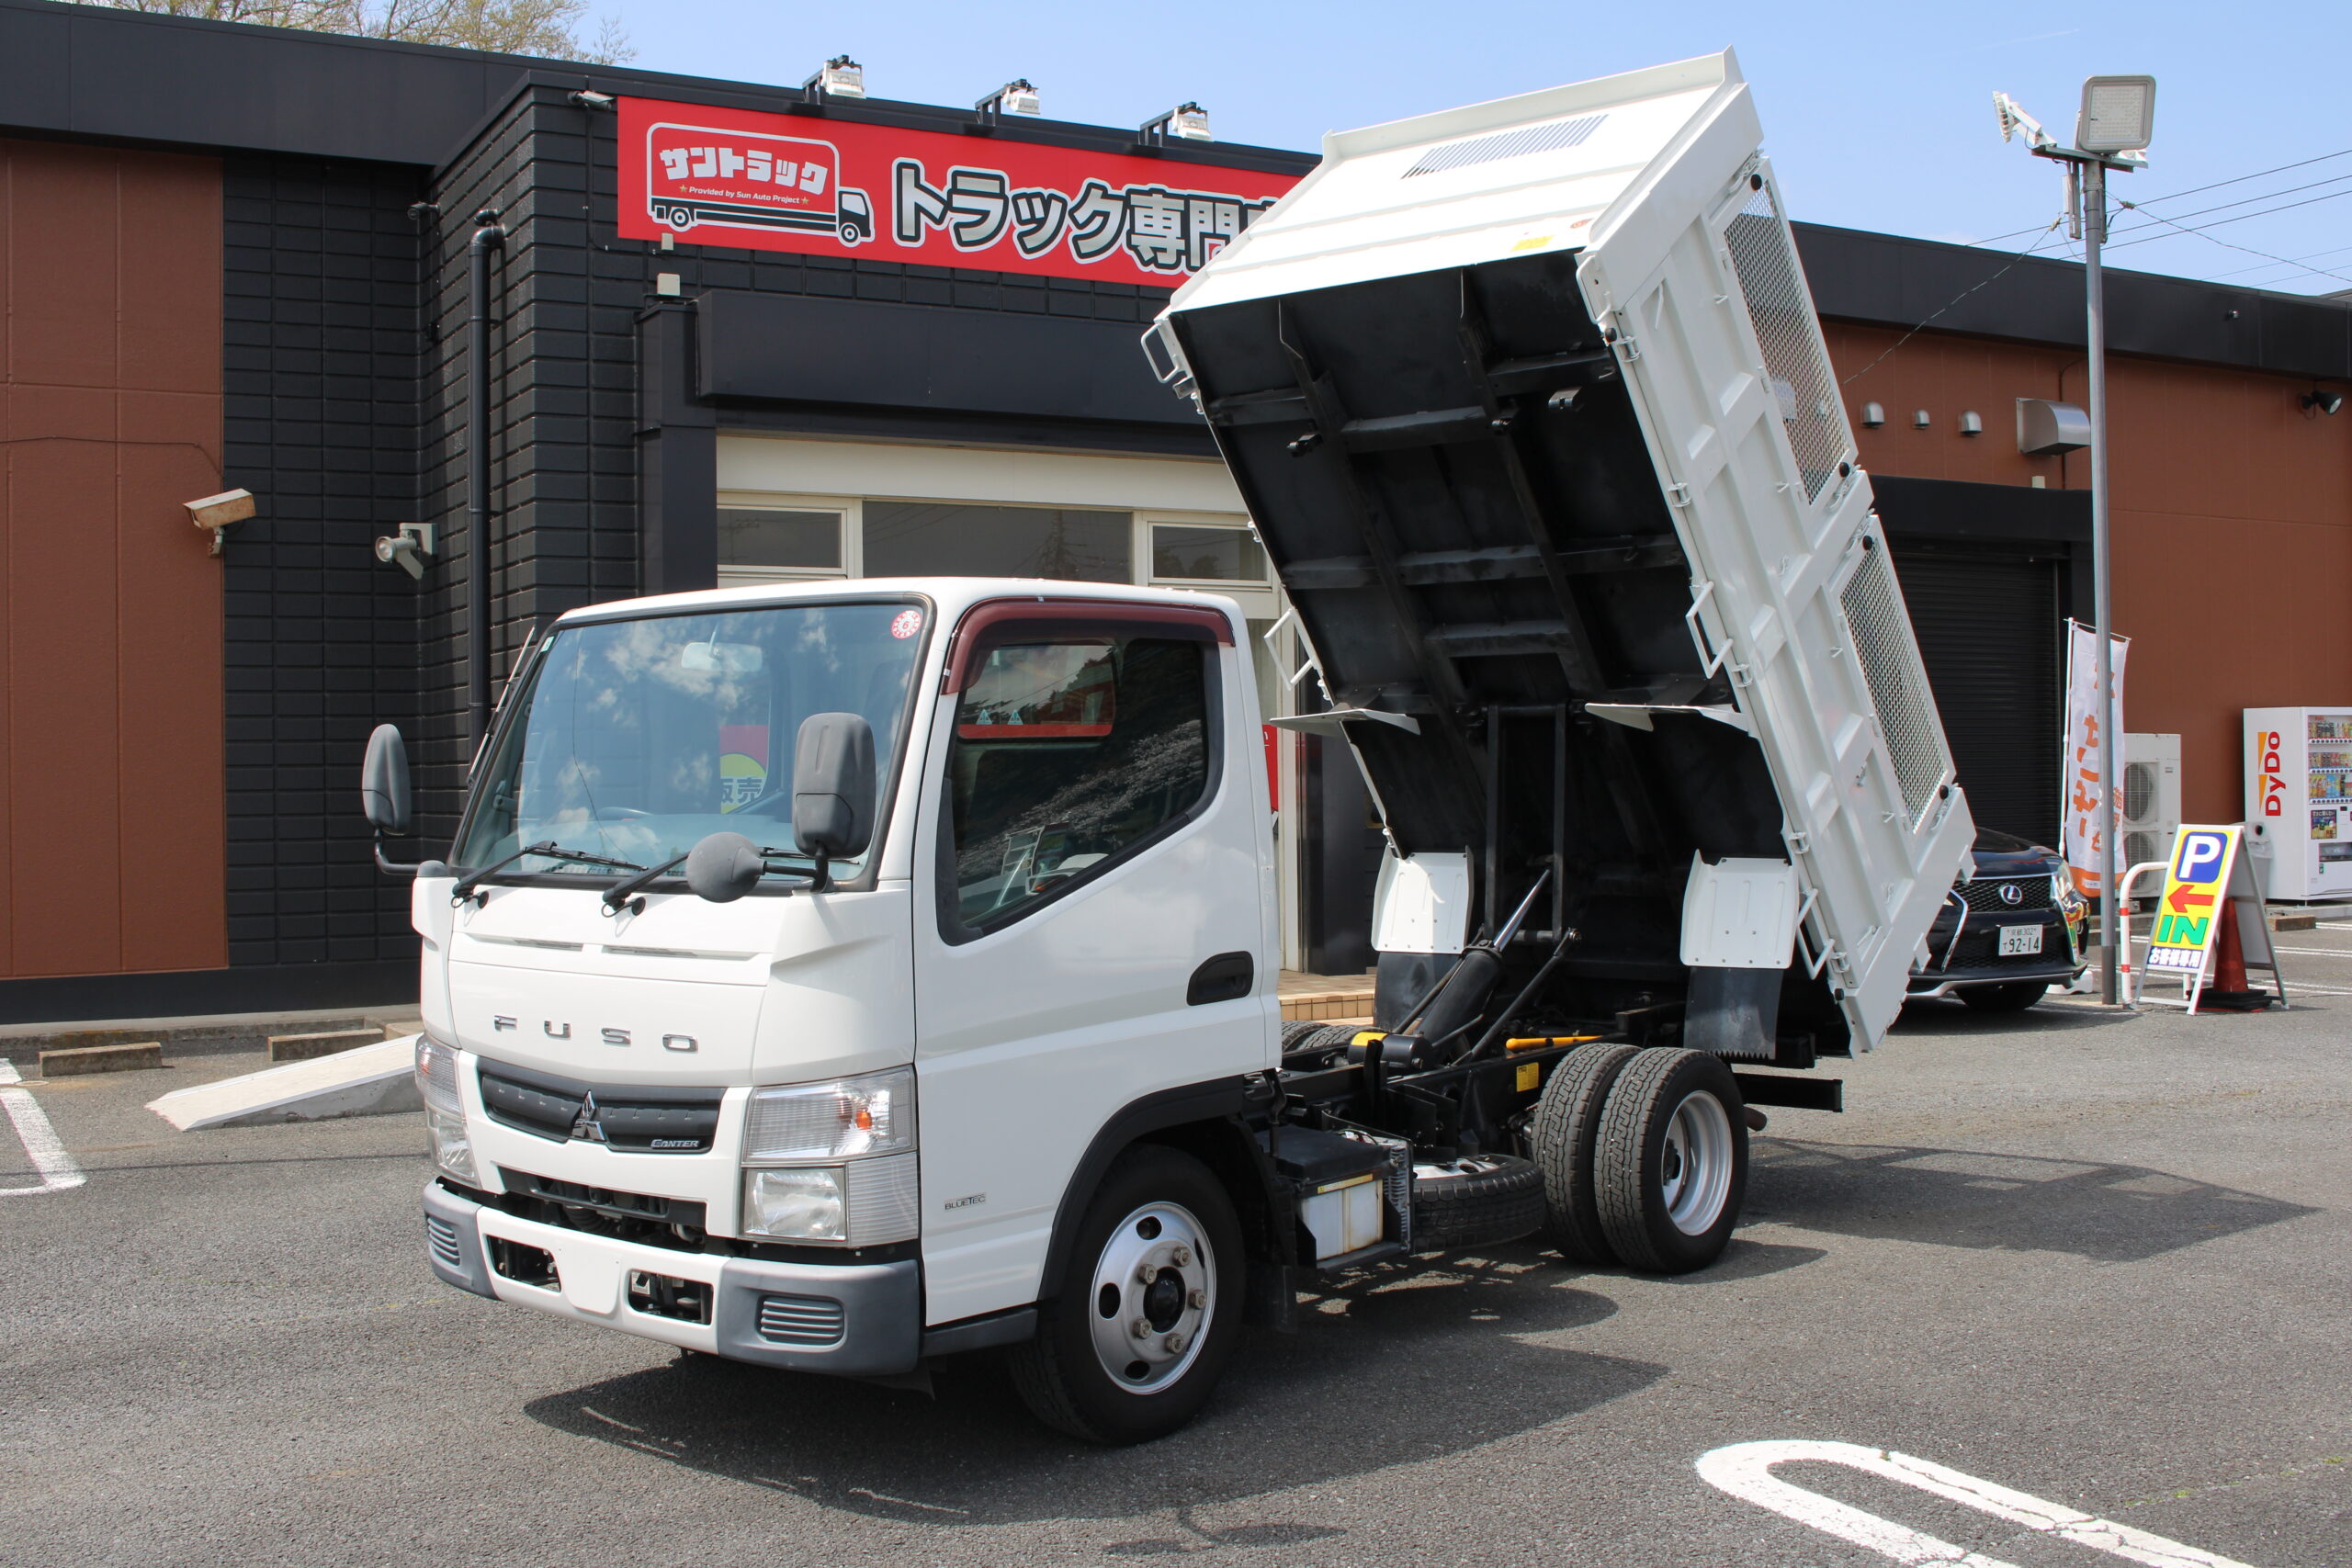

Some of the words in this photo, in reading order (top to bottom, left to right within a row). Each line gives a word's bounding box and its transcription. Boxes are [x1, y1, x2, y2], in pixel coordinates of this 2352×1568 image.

[660, 147, 828, 196] サントラック
[689, 186, 724, 197] Provided
[726, 190, 735, 198] by
[736, 191, 752, 199] Sun
[753, 193, 771, 201] Auto
[773, 195, 800, 204] Project
[895, 160, 1277, 276] トラック専門
[2264, 731, 2286, 817] DyDo
[2178, 835, 2222, 879] P
[2156, 915, 2210, 946] IN
[494, 1014, 698, 1053] FUSO
[650, 1139, 700, 1148] CANTER
